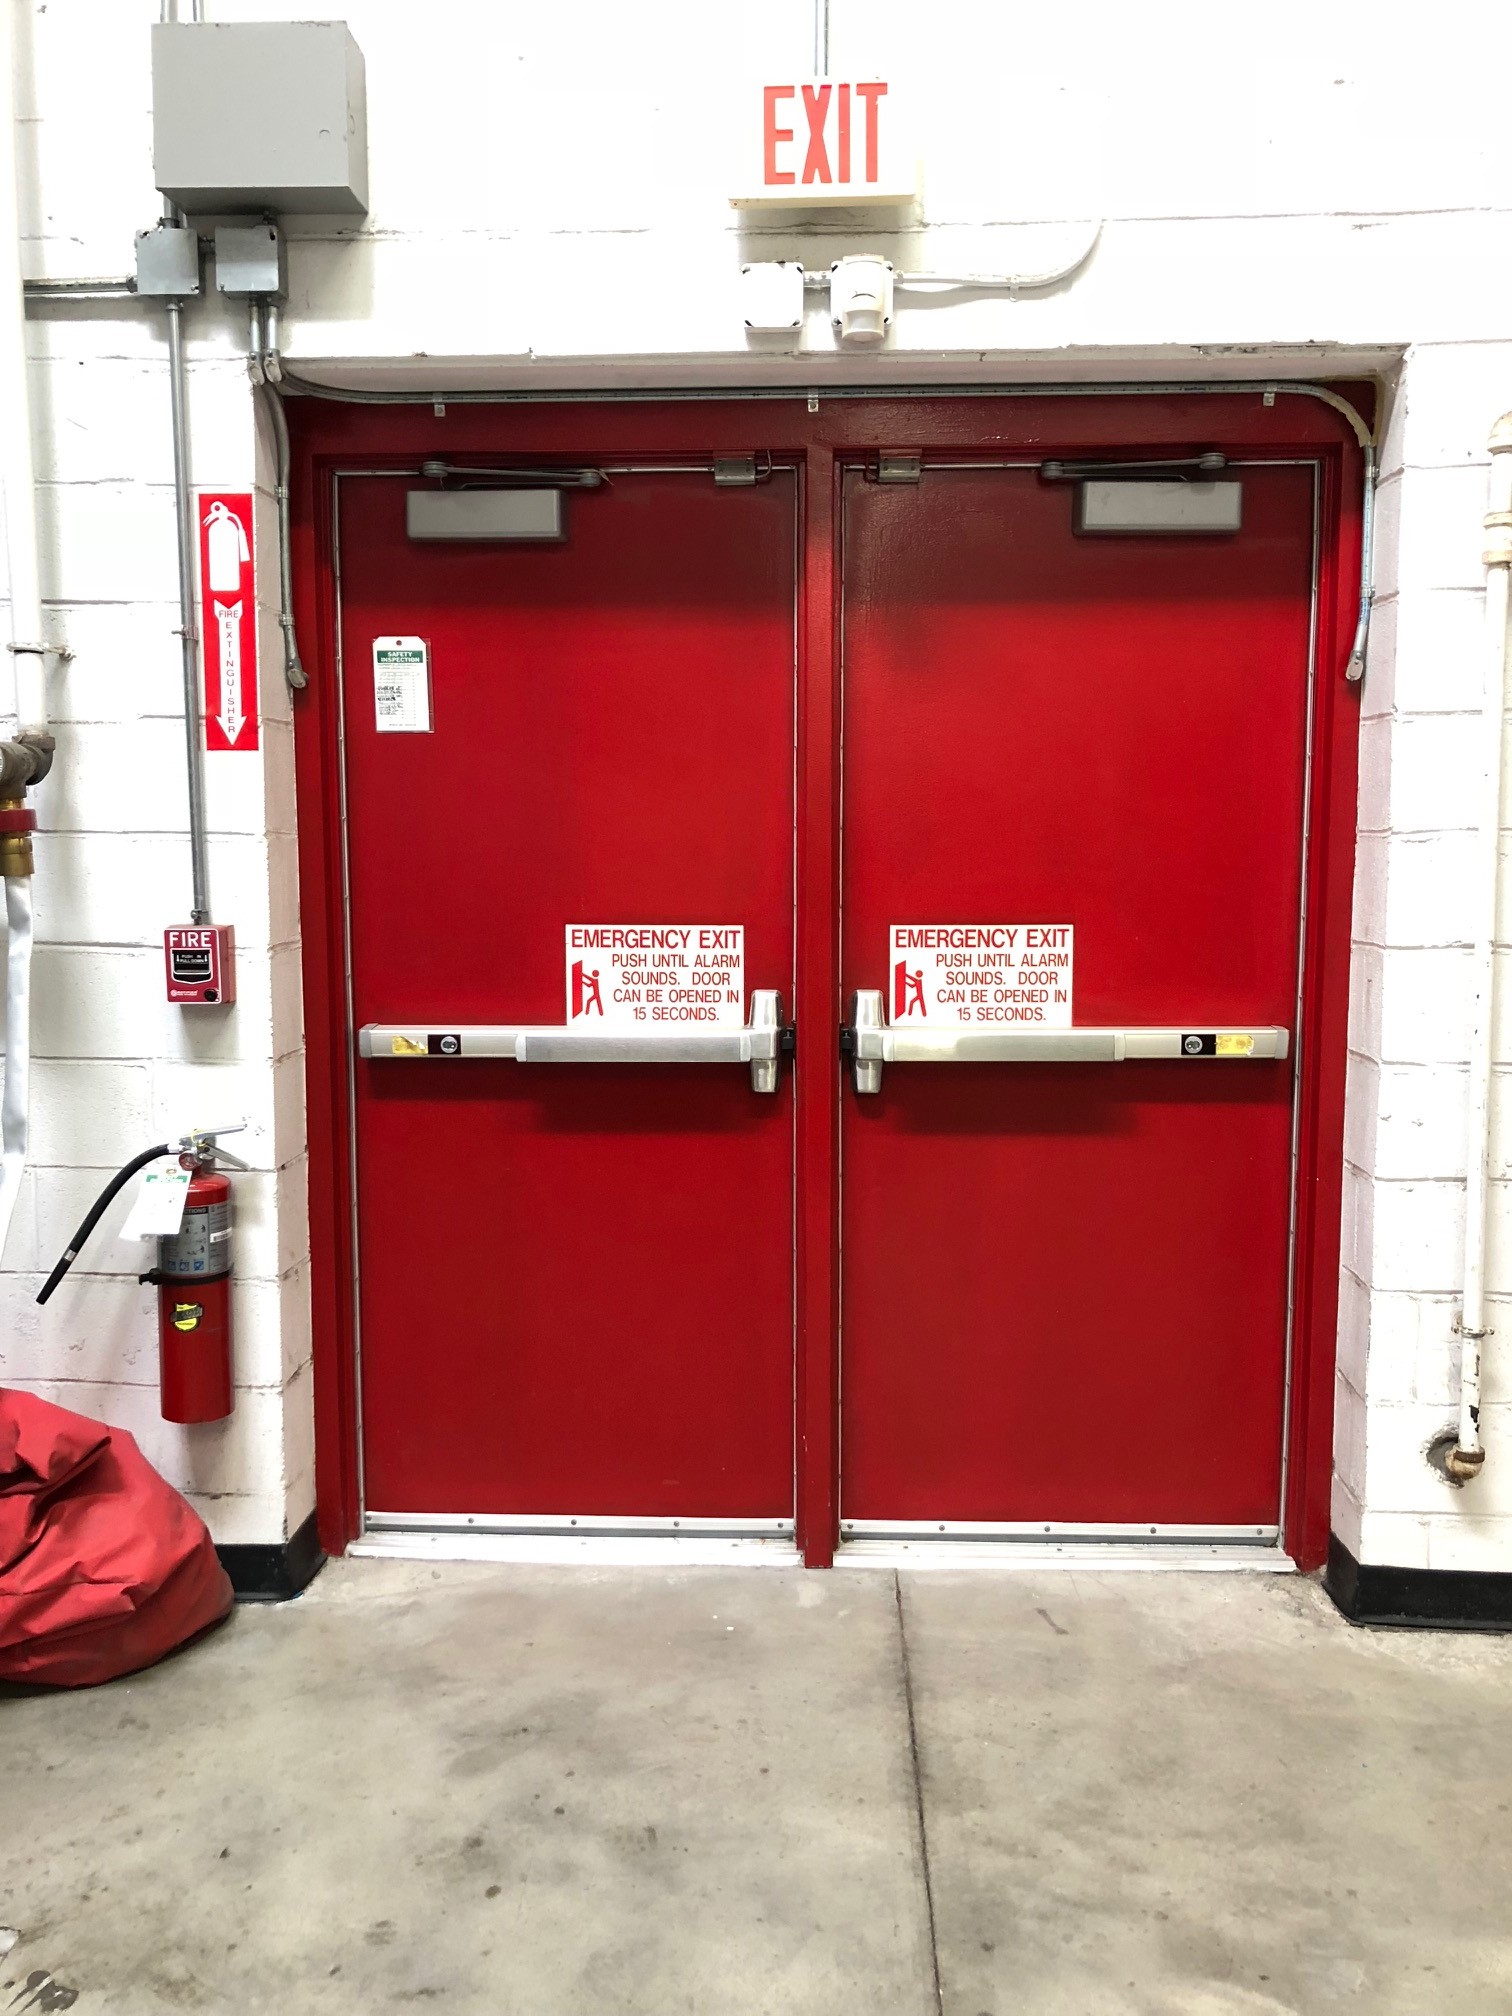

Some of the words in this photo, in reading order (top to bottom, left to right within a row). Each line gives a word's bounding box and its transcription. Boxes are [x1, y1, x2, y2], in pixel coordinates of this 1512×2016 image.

[764, 83, 888, 185] EXIT
[218, 610, 238, 618] FIRE
[225, 622, 236, 733] EXTINGUISHER
[169, 932, 212, 947] FIRE
[572, 929, 691, 949] EMERGENCY
[699, 930, 741, 949] EXIT
[895, 929, 1018, 948] EMERGENCY
[1026, 929, 1070, 948] EXIT
[612, 954, 647, 967] PUSH
[652, 954, 689, 968] UNTIL
[694, 954, 740, 968] ALARM
[936, 954, 972, 967] PUSH
[977, 954, 1015, 967] UNTIL
[1021, 954, 1068, 967] ALARM
[622, 971, 680, 985] SOUNDS.
[692, 972, 731, 985] DOOR
[945, 971, 1006, 985] SOUNDS.
[1018, 971, 1058, 985] DOOR
[613, 989, 641, 1002] CAN
[646, 990, 663, 1002] BE
[668, 990, 722, 1003] OPENED
[727, 990, 739, 1003] IN
[937, 989, 965, 1002] CAN
[971, 990, 988, 1002] BE
[994, 989, 1048, 1003] OPENED
[1054, 990, 1067, 1002] IN
[633, 1007, 646, 1020] 15
[652, 1007, 720, 1021] SECONDS.
[957, 1007, 971, 1020] 15
[976, 1007, 1046, 1021] SECONDS.
